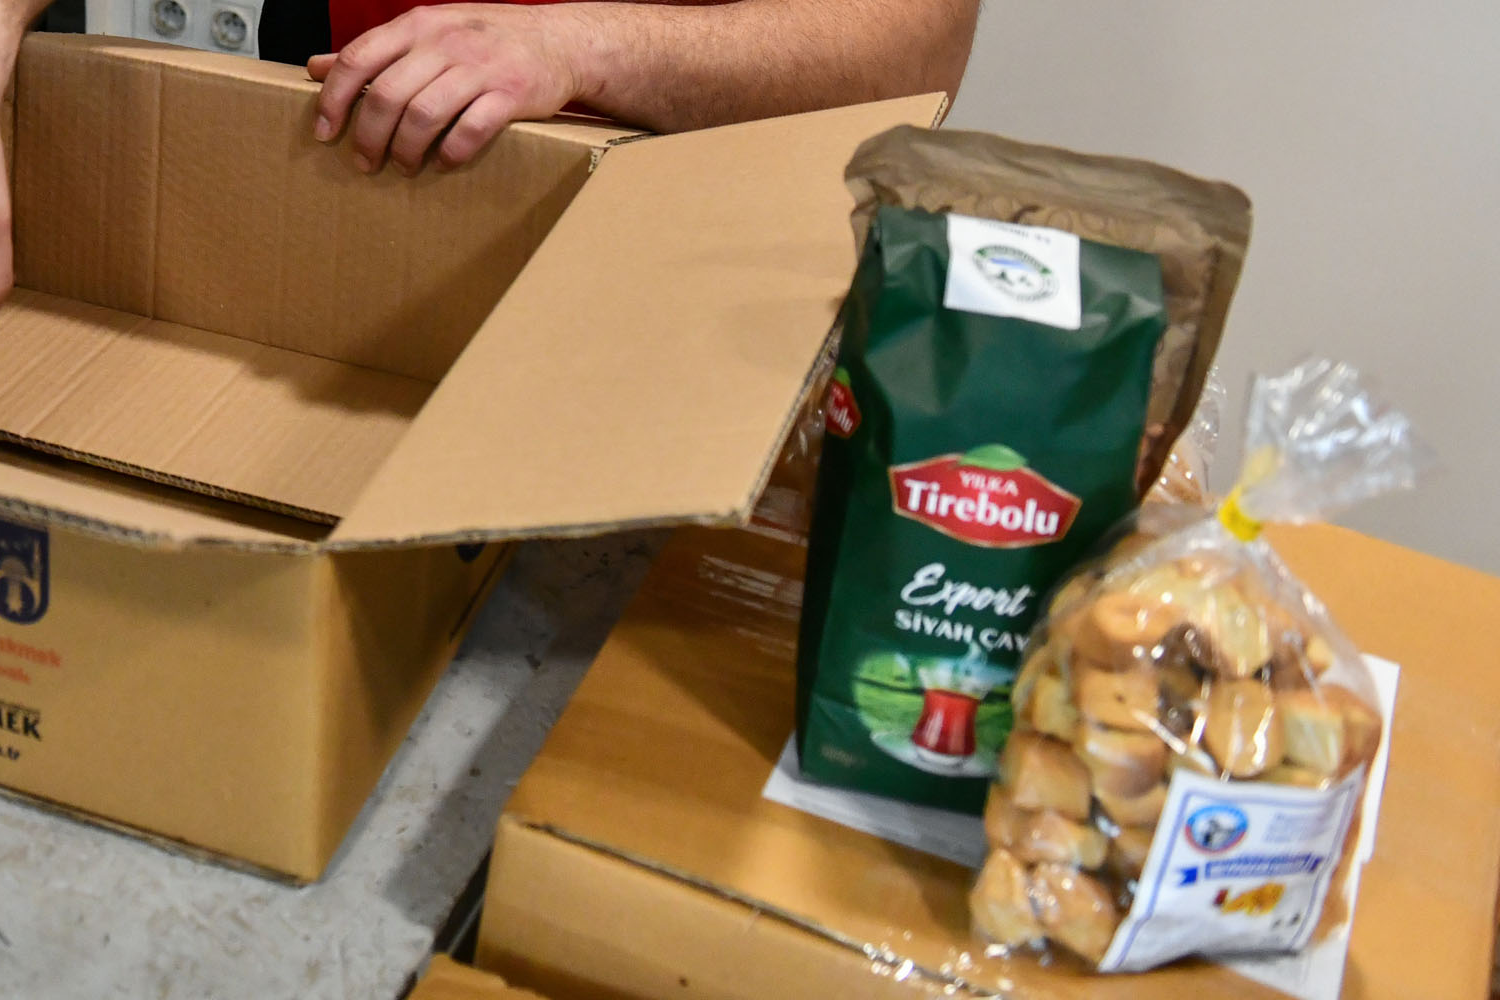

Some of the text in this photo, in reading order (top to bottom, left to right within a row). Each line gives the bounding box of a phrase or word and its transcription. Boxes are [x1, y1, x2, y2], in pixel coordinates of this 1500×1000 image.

[959, 470, 1019, 497] YILKA
[903, 478, 1060, 536] Tirebolu
[900, 563, 1032, 617] Export
[894, 608, 974, 643] SİYAH
